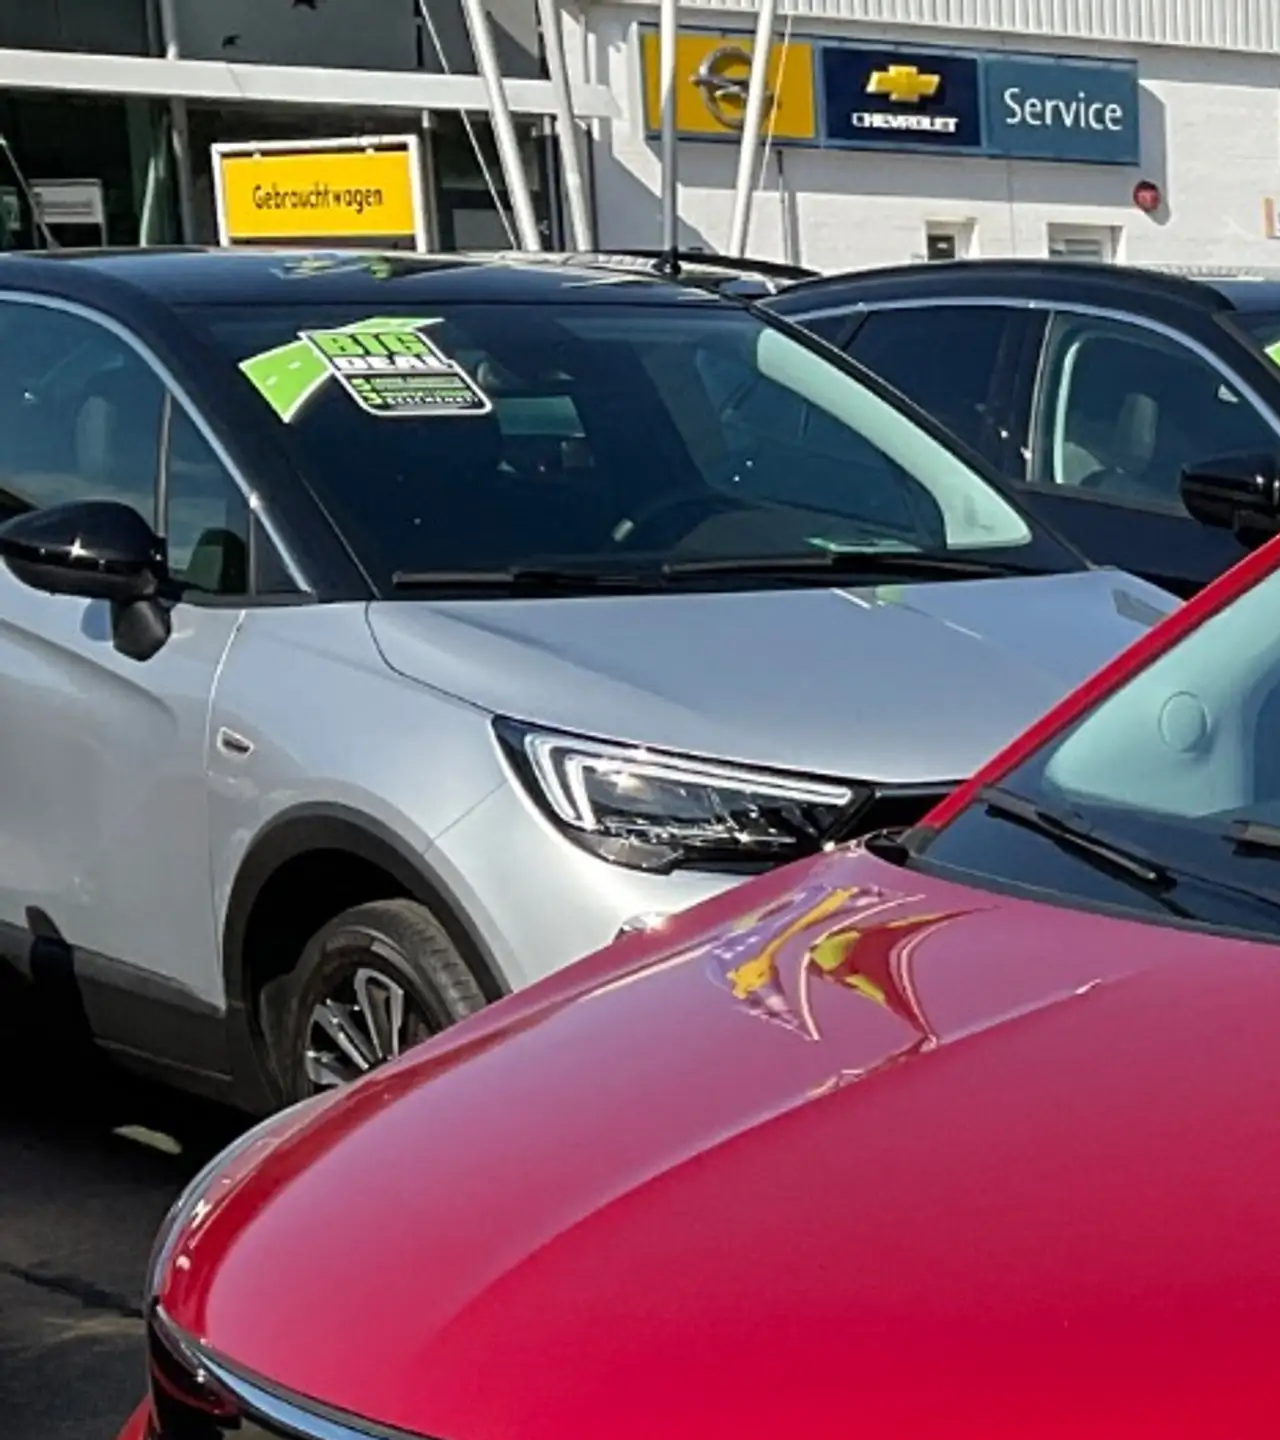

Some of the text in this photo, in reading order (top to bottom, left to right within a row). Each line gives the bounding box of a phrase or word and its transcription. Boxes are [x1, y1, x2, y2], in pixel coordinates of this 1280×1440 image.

[1003, 87, 1123, 131] Service
[852, 111, 959, 133] CHEVROLET
[252, 181, 383, 214] Gebrauchtwagen
[310, 332, 431, 356] BIG
[331, 354, 456, 370] DEAL
